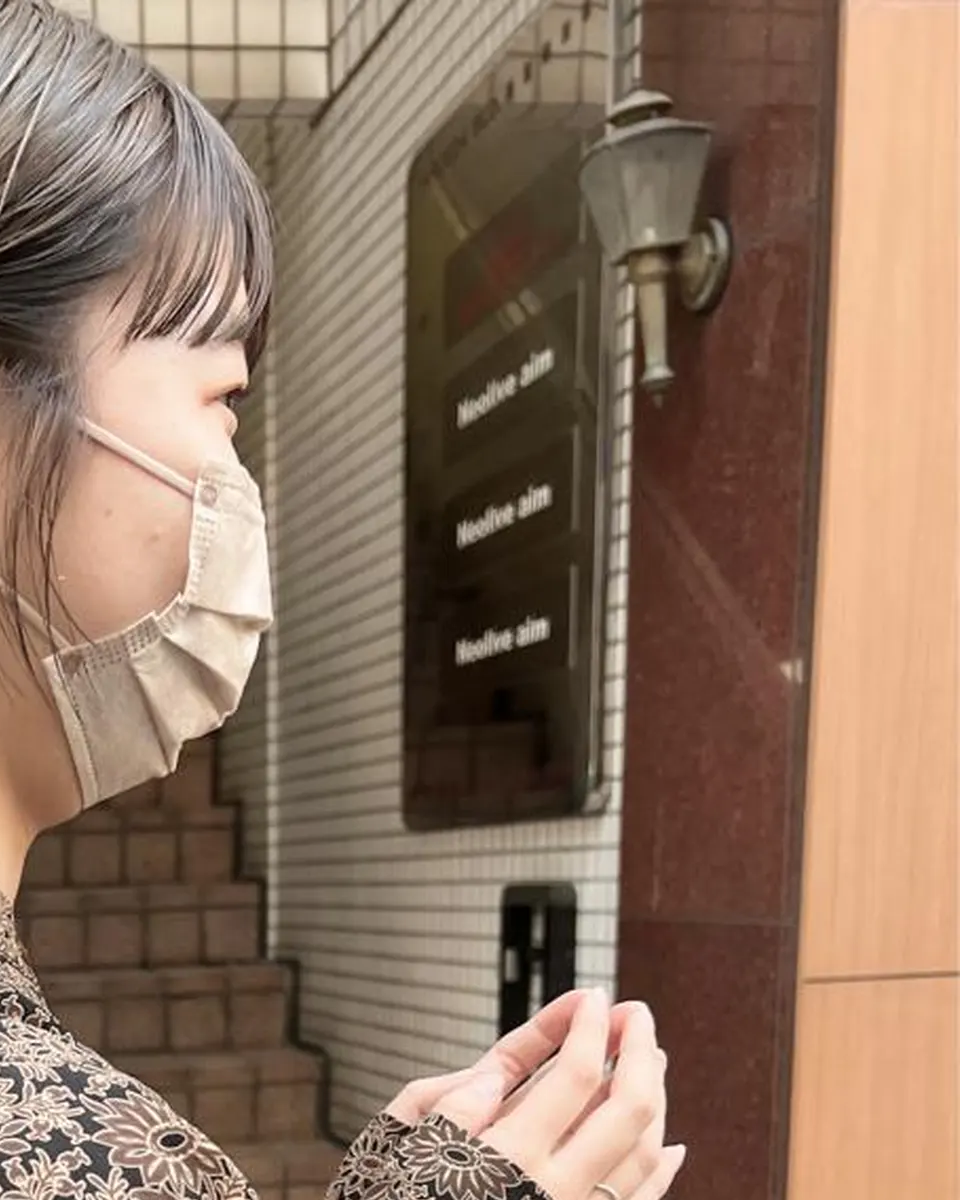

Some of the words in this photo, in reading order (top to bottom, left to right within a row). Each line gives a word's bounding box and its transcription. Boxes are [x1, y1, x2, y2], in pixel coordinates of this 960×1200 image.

[520, 348, 555, 388] aim
[518, 484, 553, 519] aim
[515, 615, 551, 648] aim
